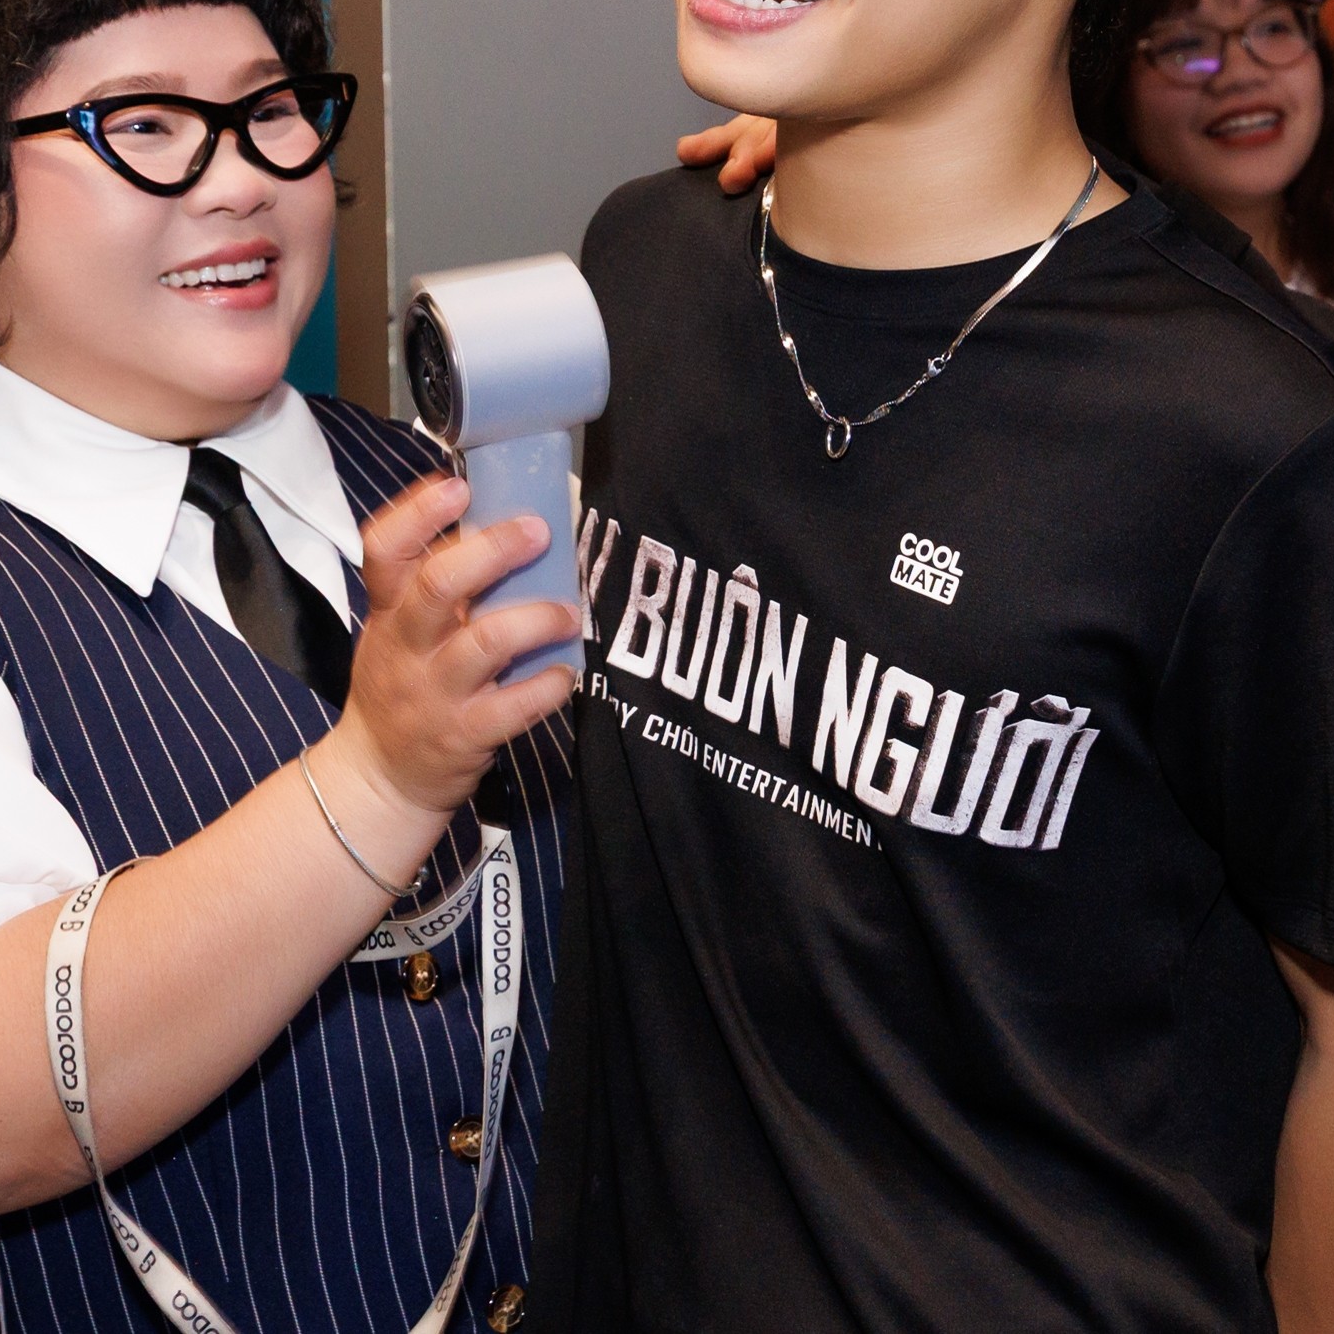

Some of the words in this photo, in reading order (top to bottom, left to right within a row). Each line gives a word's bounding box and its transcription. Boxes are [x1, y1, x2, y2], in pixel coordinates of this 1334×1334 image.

[894, 559, 955, 600] MATE
[900, 532, 964, 577] COOL
[606, 535, 809, 749] BUÔN
[812, 637, 1101, 851] NGƯỜI
[702, 743, 883, 851] ENTERTAINMEN
